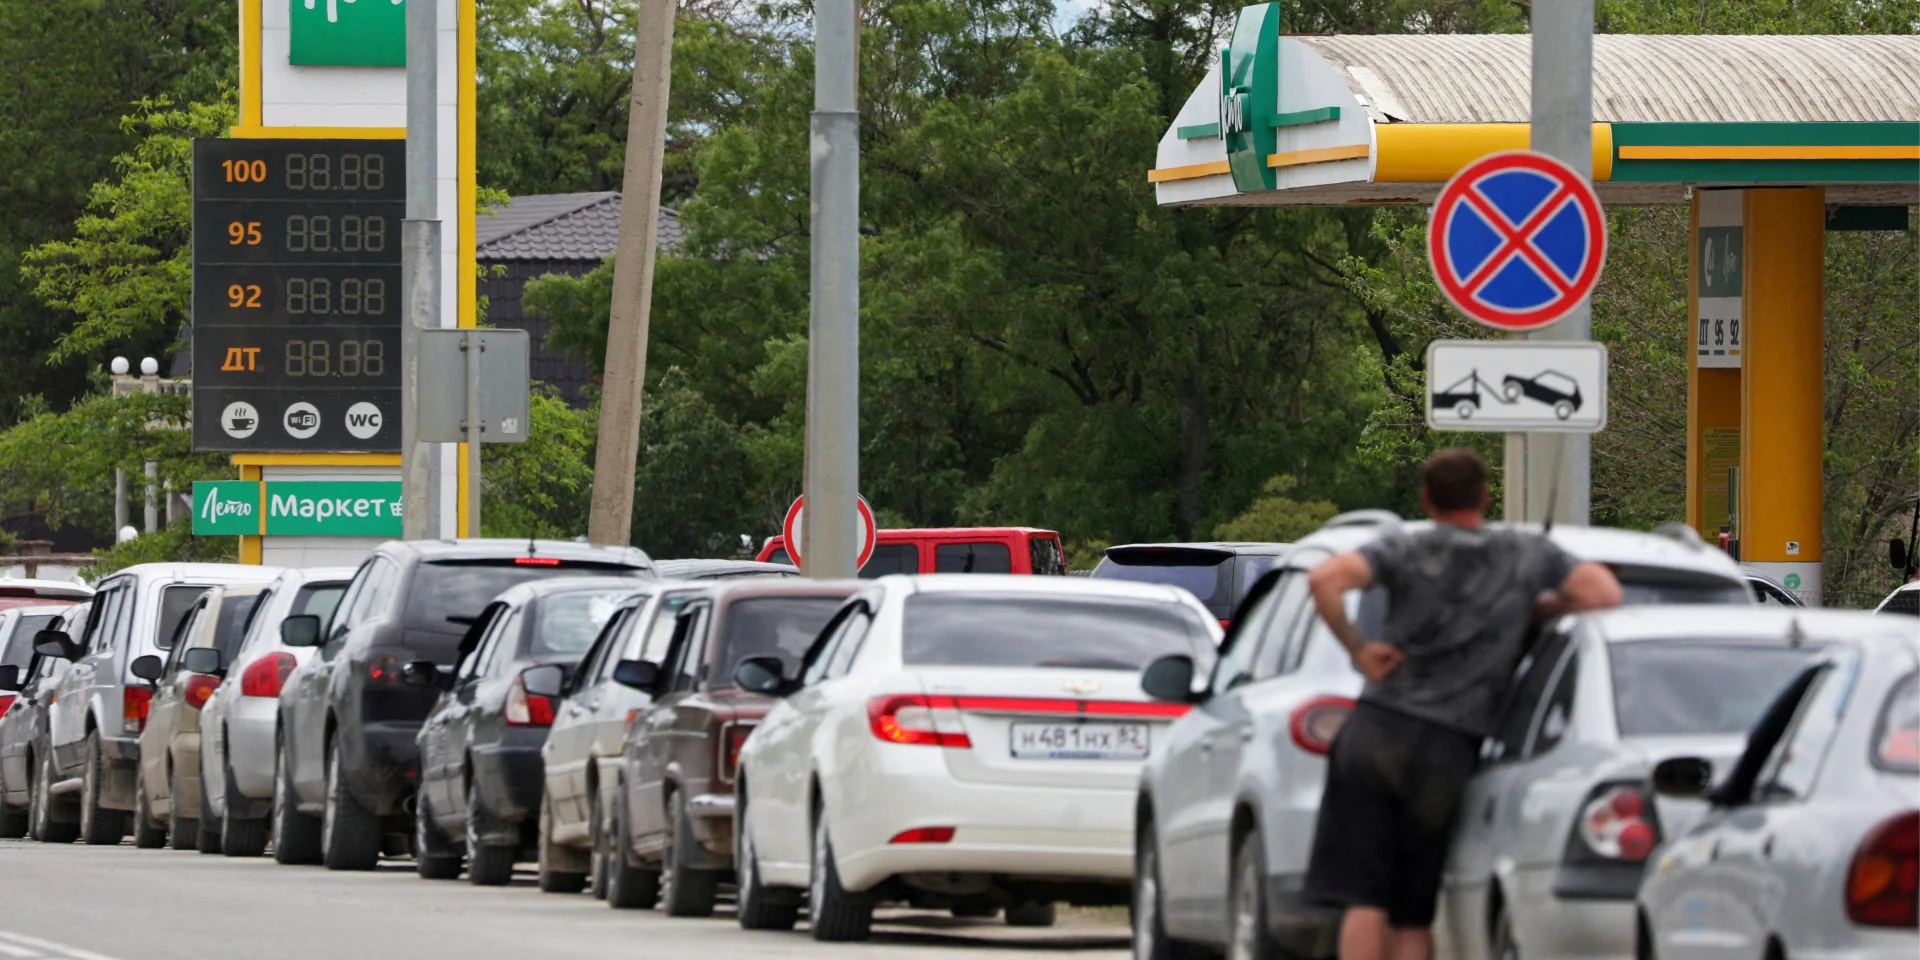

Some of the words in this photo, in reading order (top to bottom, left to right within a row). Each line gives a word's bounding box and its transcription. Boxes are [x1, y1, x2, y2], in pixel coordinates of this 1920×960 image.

[222, 159, 267, 183] 100
[228, 221, 263, 245] 95
[228, 284, 262, 308] 92
[1714, 318, 1724, 346] 95
[1730, 318, 1739, 346] 92
[221, 347, 261, 371] ДТ
[349, 413, 380, 427] WC
[201, 486, 252, 524] Лето
[270, 493, 386, 523] Маркет
